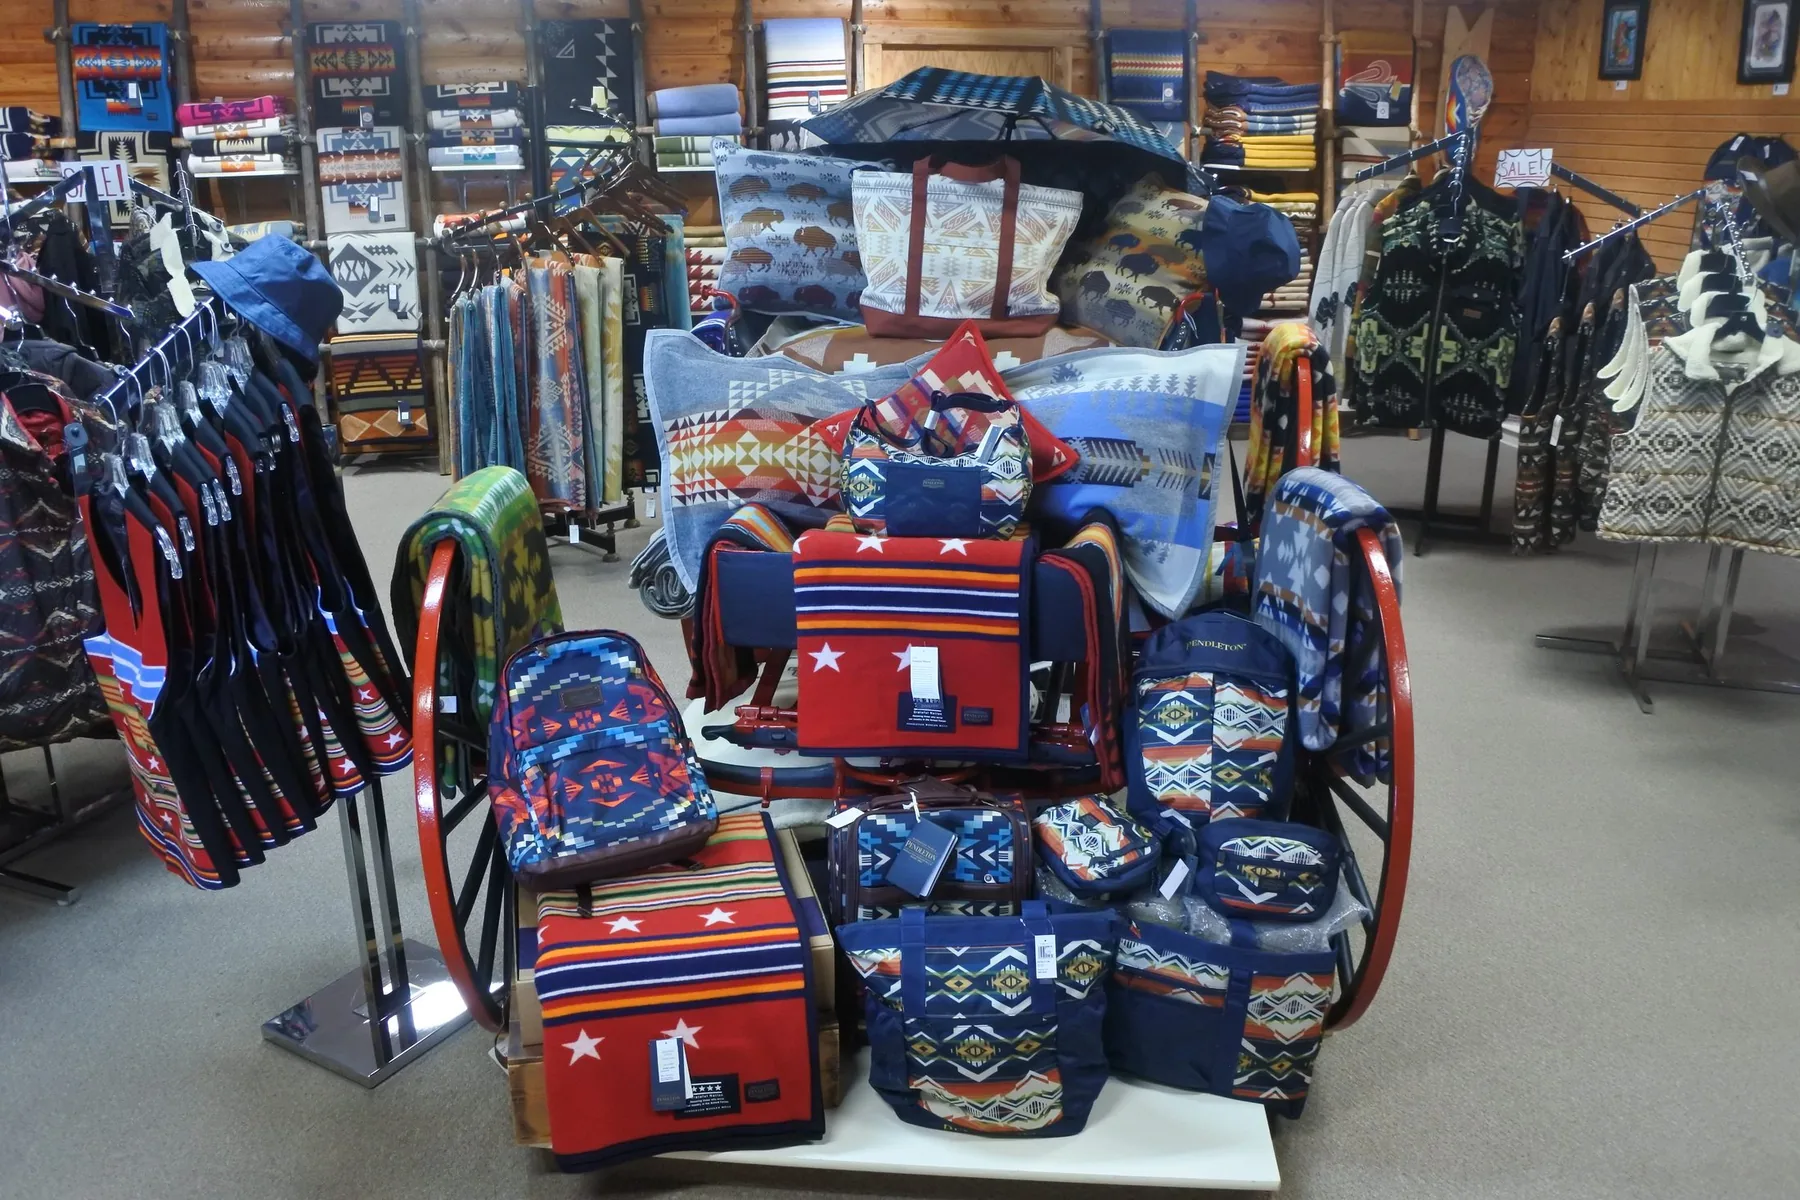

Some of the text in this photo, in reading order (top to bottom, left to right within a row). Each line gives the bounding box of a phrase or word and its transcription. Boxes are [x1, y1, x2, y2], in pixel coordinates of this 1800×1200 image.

[1500, 161, 1543, 177] SALE!
[64, 163, 125, 198] SE!
[1185, 639, 1245, 651] PENDLETON
[905, 839, 936, 861] PENDLETON
